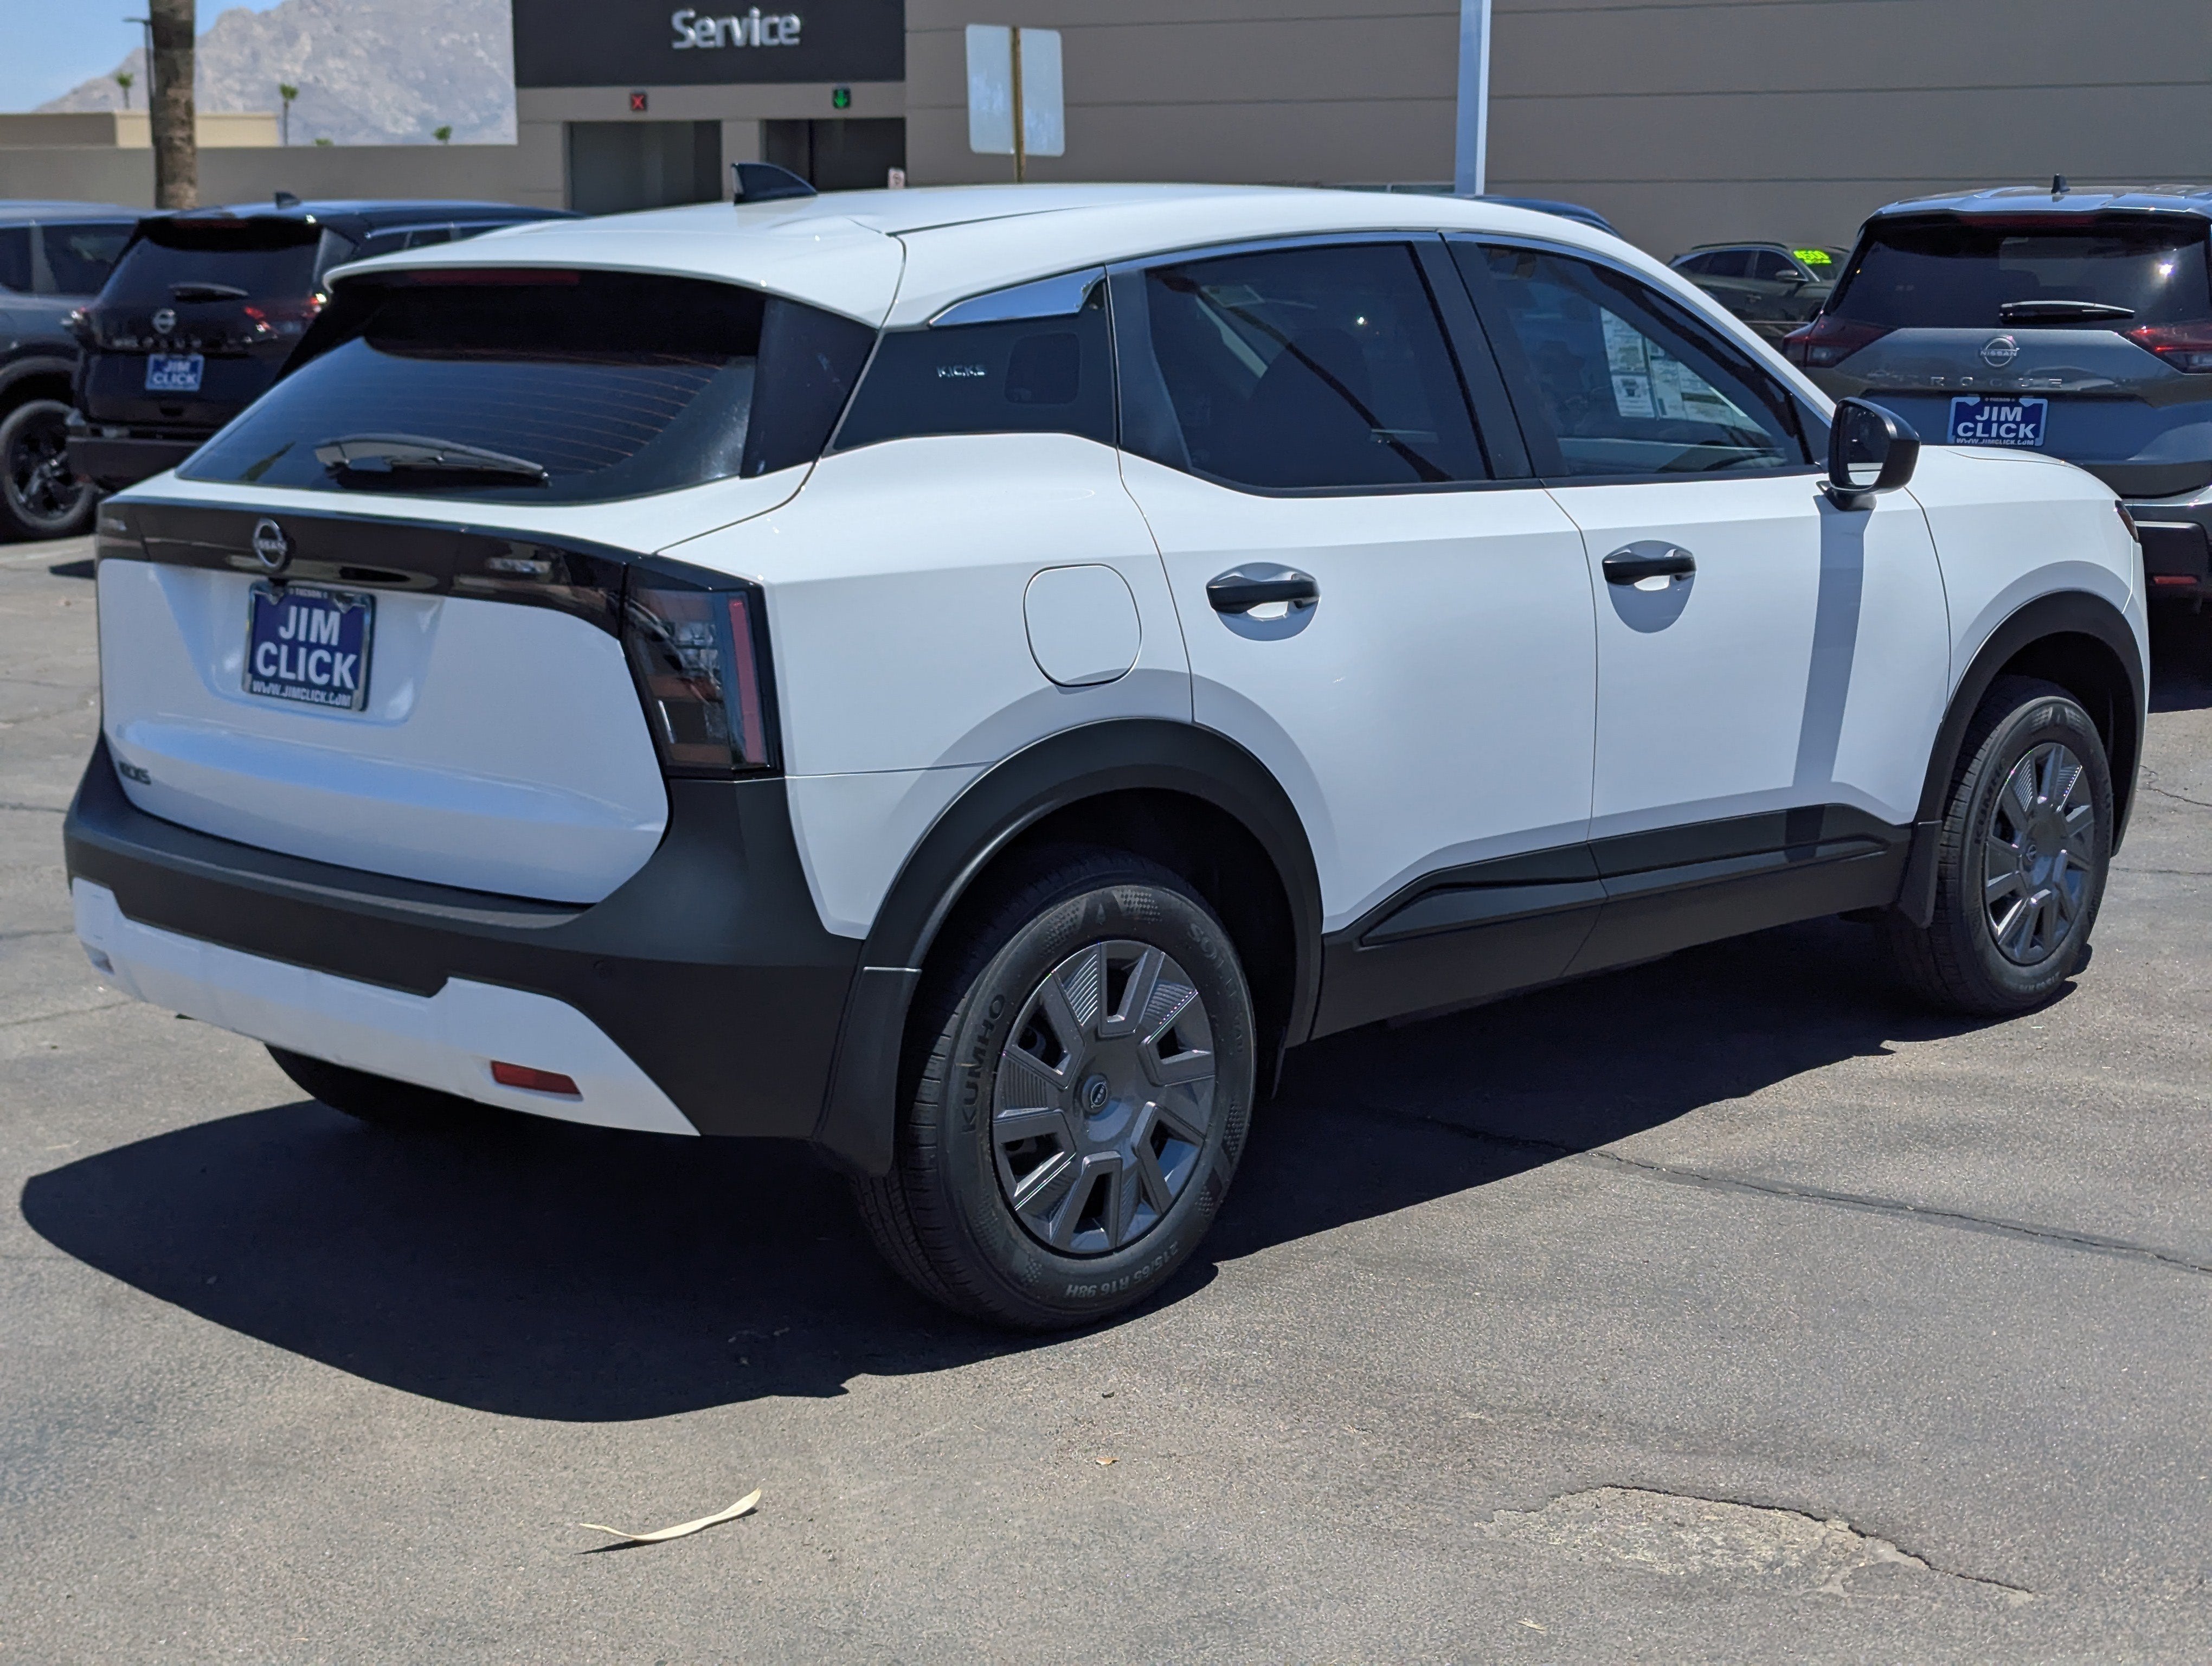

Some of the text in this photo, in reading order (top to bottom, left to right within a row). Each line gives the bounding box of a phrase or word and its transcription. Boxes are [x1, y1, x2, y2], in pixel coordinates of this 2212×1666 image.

[671, 7, 801, 49] Service
[164, 360, 190, 373] JIM
[936, 365, 986, 377] KICKS
[152, 373, 196, 385] CLICK
[1930, 376, 2062, 387] ROGUE
[1975, 406, 2022, 421] JIM
[1957, 422, 2036, 438] CLICK
[279, 605, 340, 646] JIM
[256, 642, 357, 690] CLICK
[961, 994, 1006, 1133] KUMHO
[1065, 1284, 1097, 1298] 98H
[1101, 1276, 1129, 1296] R16
